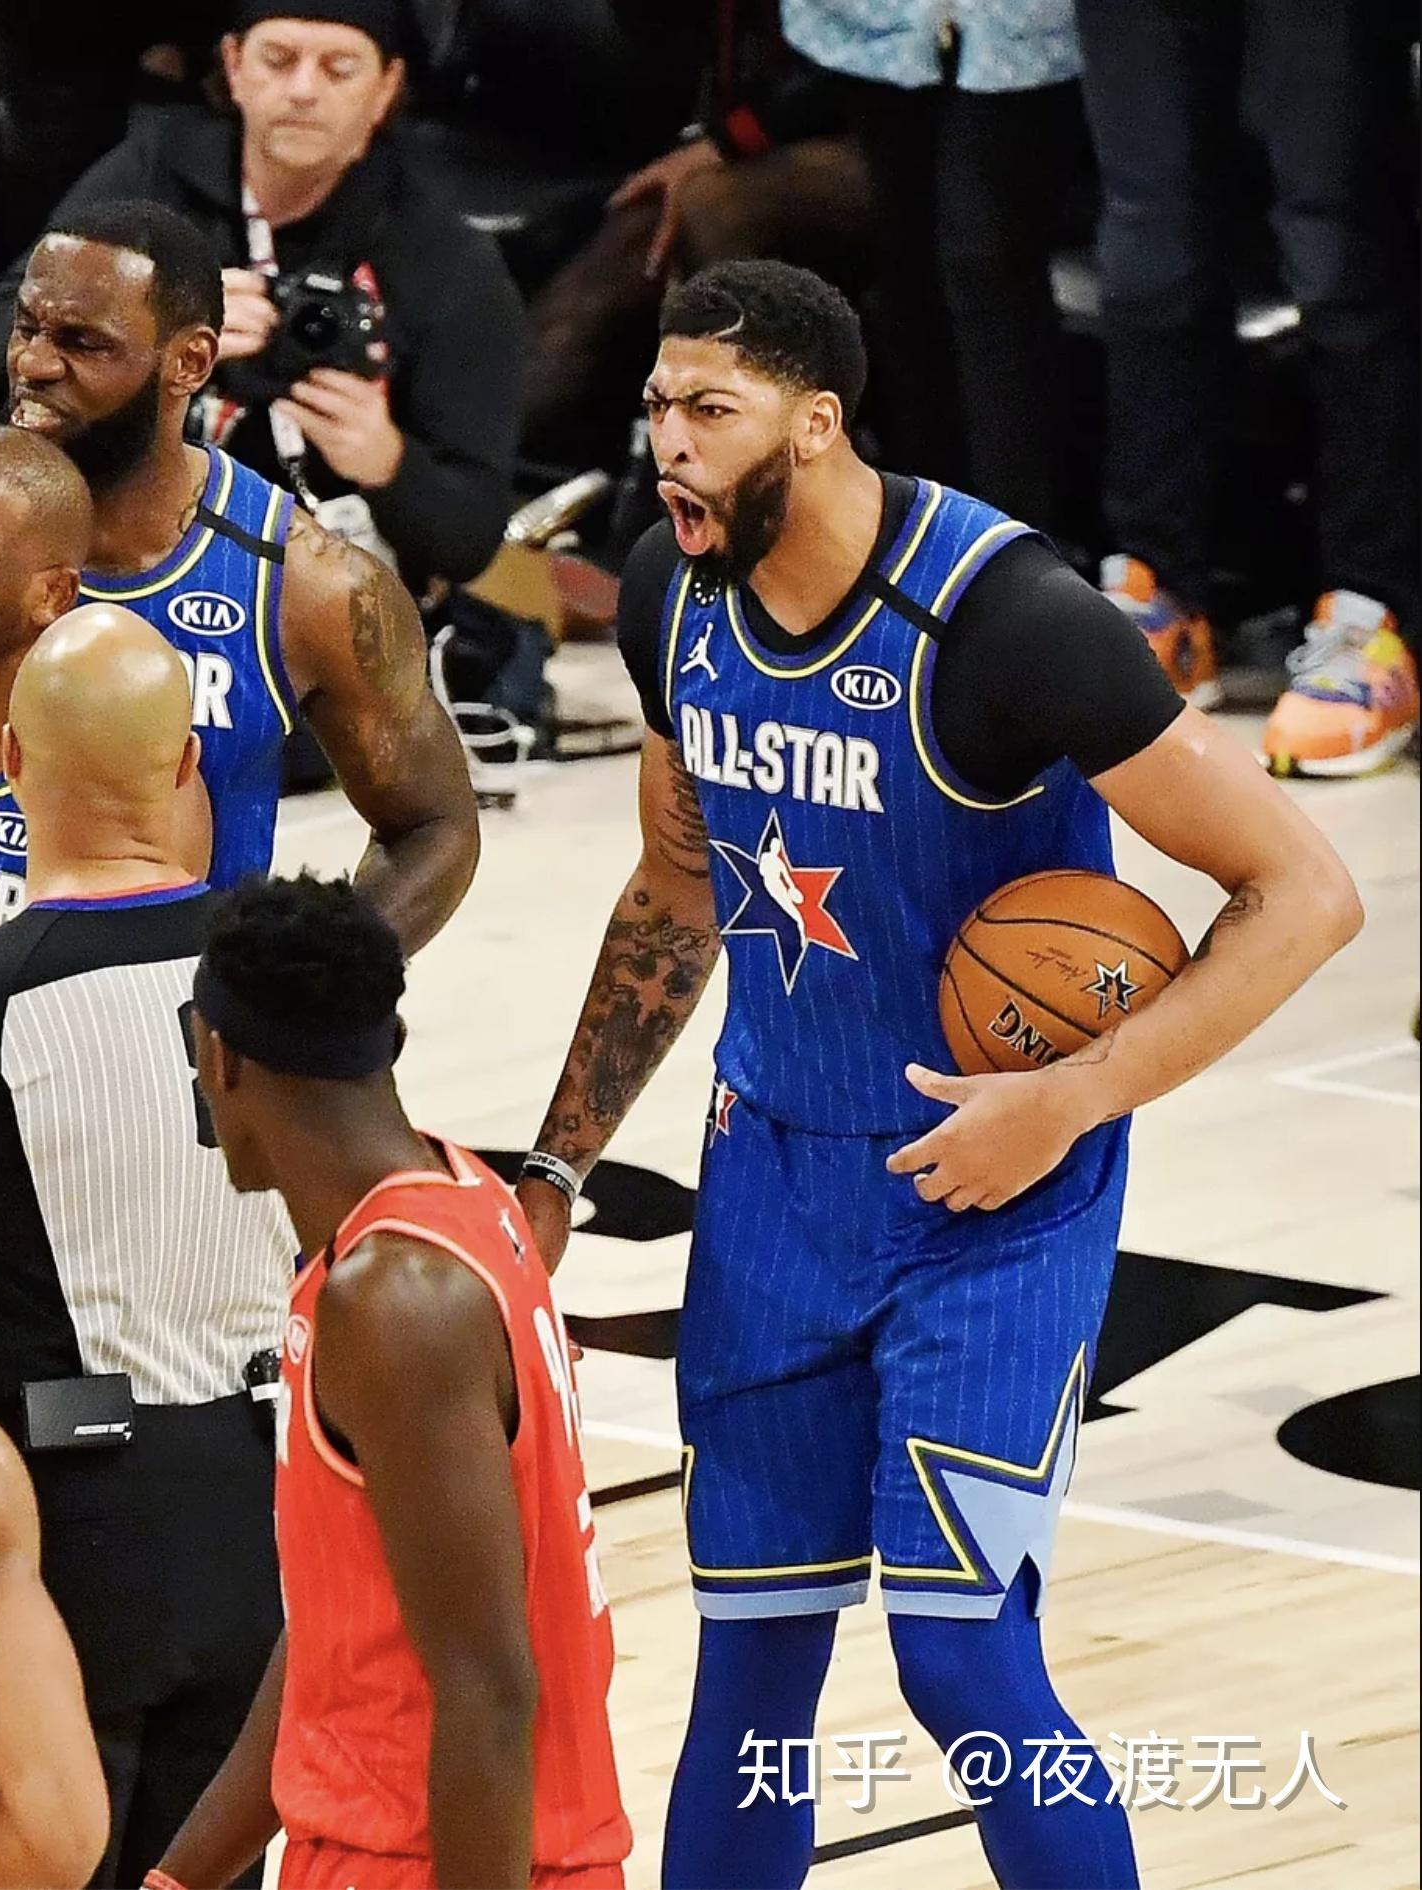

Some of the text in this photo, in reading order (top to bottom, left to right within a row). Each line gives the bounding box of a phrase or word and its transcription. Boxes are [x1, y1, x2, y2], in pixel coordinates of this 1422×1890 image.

[181, 599, 233, 628] KIA
[842, 672, 890, 703] KIA
[680, 702, 885, 814] ALL-STAR
